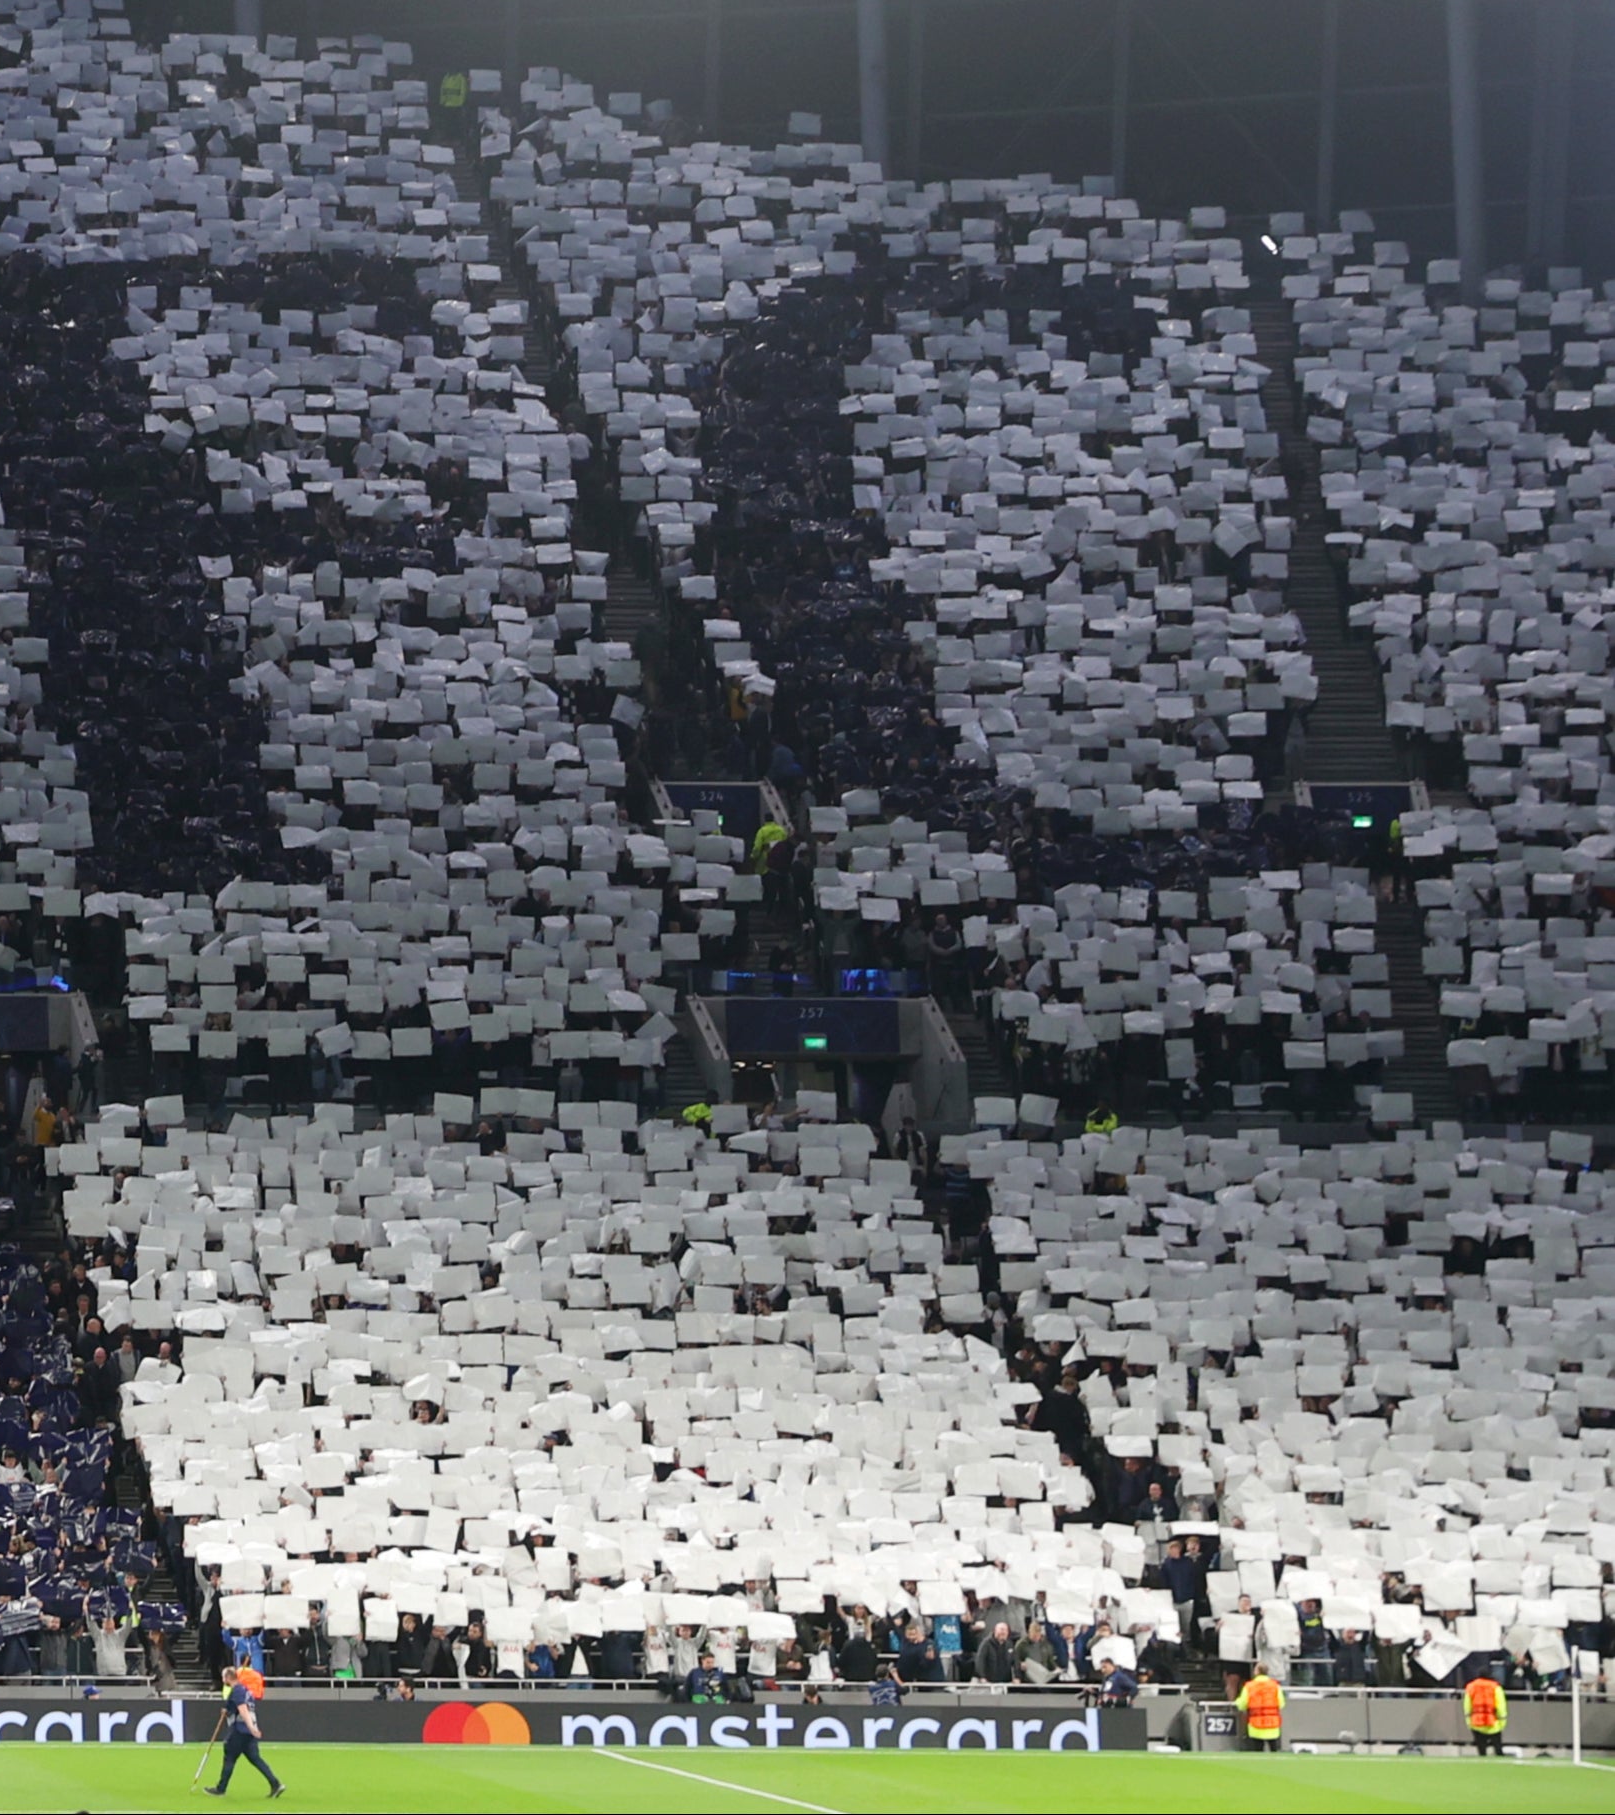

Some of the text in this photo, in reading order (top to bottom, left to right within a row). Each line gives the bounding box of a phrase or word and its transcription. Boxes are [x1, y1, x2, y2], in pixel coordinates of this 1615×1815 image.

[799, 1007, 824, 1019] 257
[503, 1645, 520, 1653] AIA
[562, 1704, 1099, 1751] mastercard
[1207, 1717, 1234, 1733] 257
